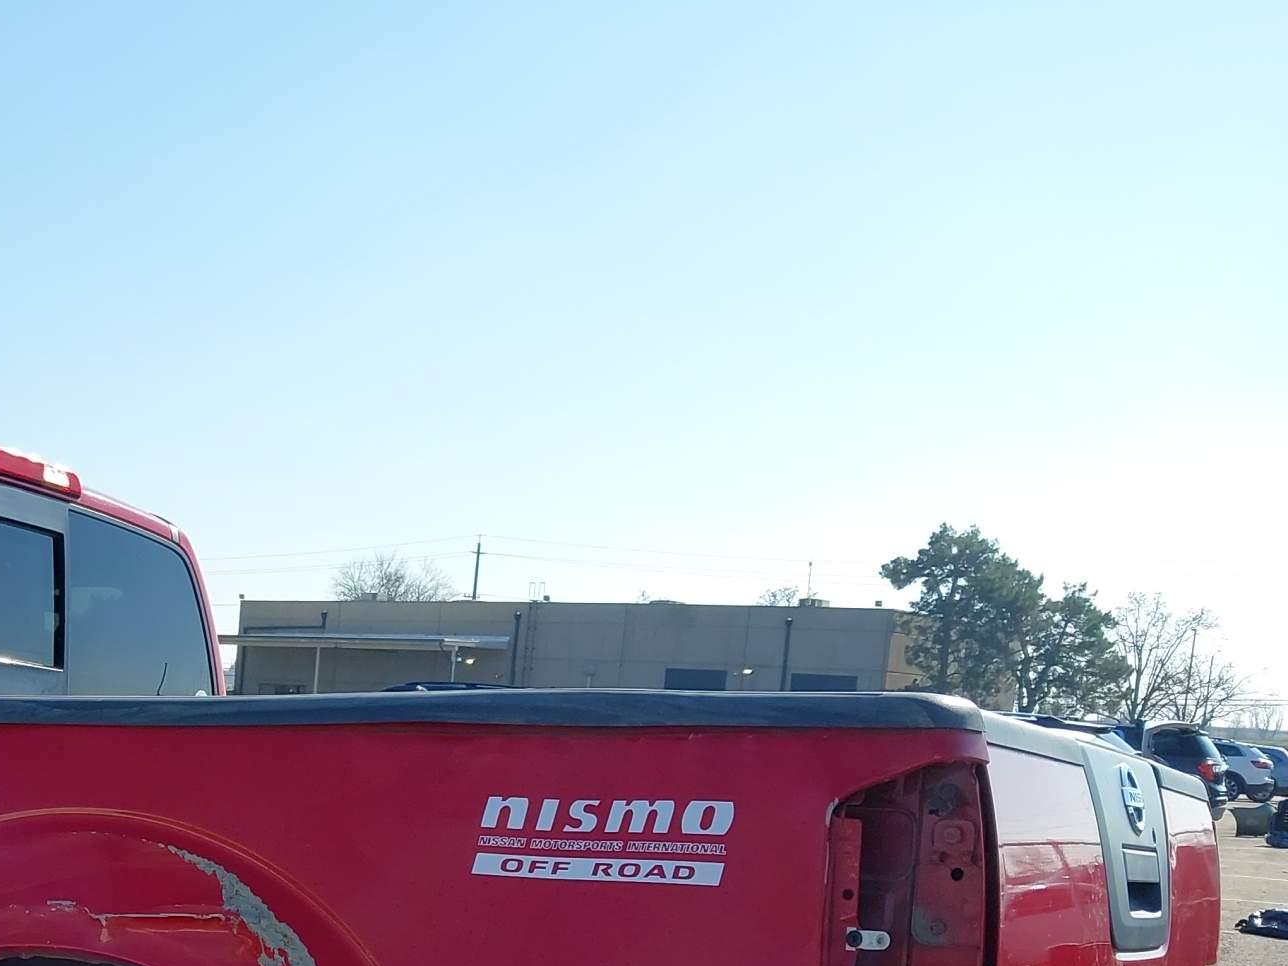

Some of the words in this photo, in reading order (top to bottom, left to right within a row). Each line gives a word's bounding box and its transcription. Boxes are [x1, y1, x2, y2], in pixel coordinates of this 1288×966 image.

[479, 796, 735, 836] nismo
[478, 836, 527, 849] NISSAN
[530, 839, 623, 852] MOTORSPORTS
[626, 842, 727, 855] INTERNATIONAL
[500, 858, 571, 875] OFF
[591, 862, 696, 880] ROAD
